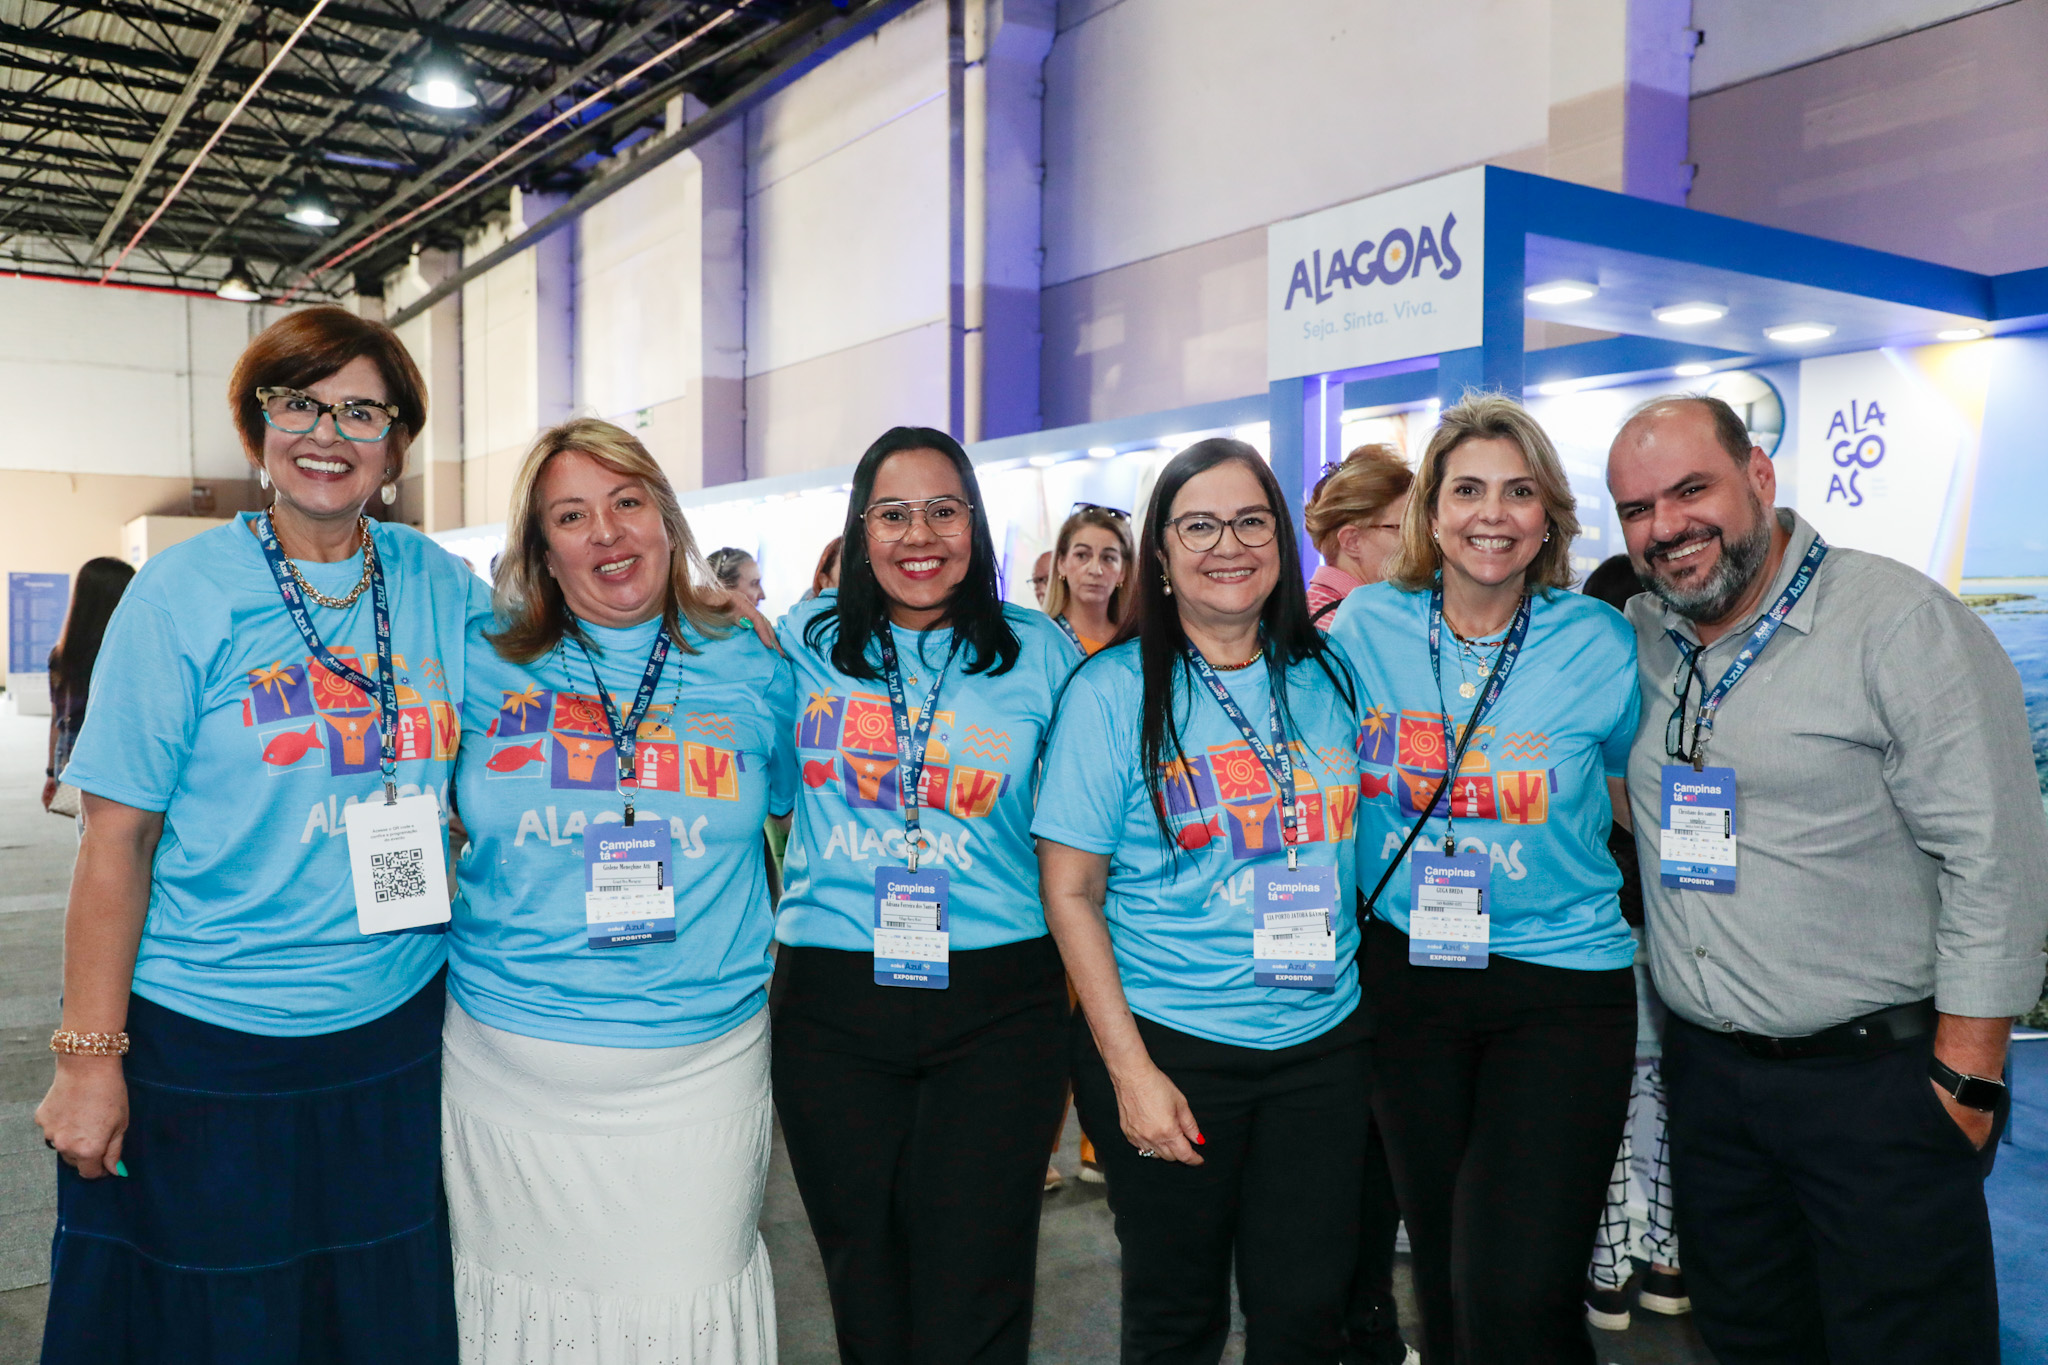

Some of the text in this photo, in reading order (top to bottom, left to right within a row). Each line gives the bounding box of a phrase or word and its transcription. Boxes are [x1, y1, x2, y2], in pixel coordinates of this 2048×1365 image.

[1284, 211, 1462, 311] ALAGOAS
[1303, 301, 1437, 341] Seja. Sinta. Viva.
[1826, 399, 1886, 440] ALA
[1833, 434, 1885, 469] GO
[1826, 469, 1863, 507] AS
[258, 518, 273, 542] Azul
[1808, 546, 1819, 558] Azul
[278, 560, 291, 577] Azul
[286, 582, 300, 604] Agente
[1788, 573, 1809, 598] Azul
[375, 583, 387, 611] Azul
[1769, 596, 1788, 618] Agente
[292, 608, 313, 637] Azul
[1515, 616, 1524, 632] Azul
[1755, 621, 1769, 638] Azul
[378, 641, 386, 658] Azul
[652, 641, 663, 662] Agente
[327, 657, 345, 671] Azul
[646, 663, 655, 677] Azul
[1192, 655, 1214, 678] Azul
[1498, 654, 1514, 681] Azul
[349, 671, 373, 688] Agente
[888, 671, 902, 693] Azul
[1722, 662, 1746, 688] Azul
[384, 684, 397, 711] Azul
[1208, 681, 1225, 701] Agente
[1486, 681, 1498, 703] Agente
[633, 694, 650, 714] Azul
[921, 694, 935, 719] Azul
[1223, 703, 1237, 718] Azul
[610, 714, 623, 736] Azul
[900, 715, 909, 730] Azul
[620, 735, 628, 751] Azul
[903, 735, 911, 760] Agente
[1249, 737, 1271, 760] Azul
[915, 745, 925, 763] Azul
[1266, 763, 1284, 784] Agente
[1278, 754, 1292, 780] Azul
[901, 764, 915, 792] Azul
[1673, 782, 1722, 795] Campinas
[1673, 792, 1683, 801] tá
[514, 806, 709, 859] ALAAS
[600, 839, 656, 851] Campinas
[600, 850, 611, 860] tá
[1424, 865, 1476, 878] Campinas
[1691, 866, 1708, 874] Azul
[887, 882, 935, 894] Campinas
[1268, 882, 1321, 894] Campinas
[1424, 875, 1434, 884] tá
[1679, 876, 1715, 886] EXPOSITOR
[887, 892, 896, 900] tá
[1268, 891, 1278, 900] tá
[624, 923, 645, 931] Azul
[611, 934, 652, 942] EXPOSITOR
[905, 962, 922, 970] Azul
[1429, 954, 1467, 962] EXPOSITOR
[893, 974, 928, 982] EXPOSITOR
[1275, 974, 1313, 982] EXPOSITOR
